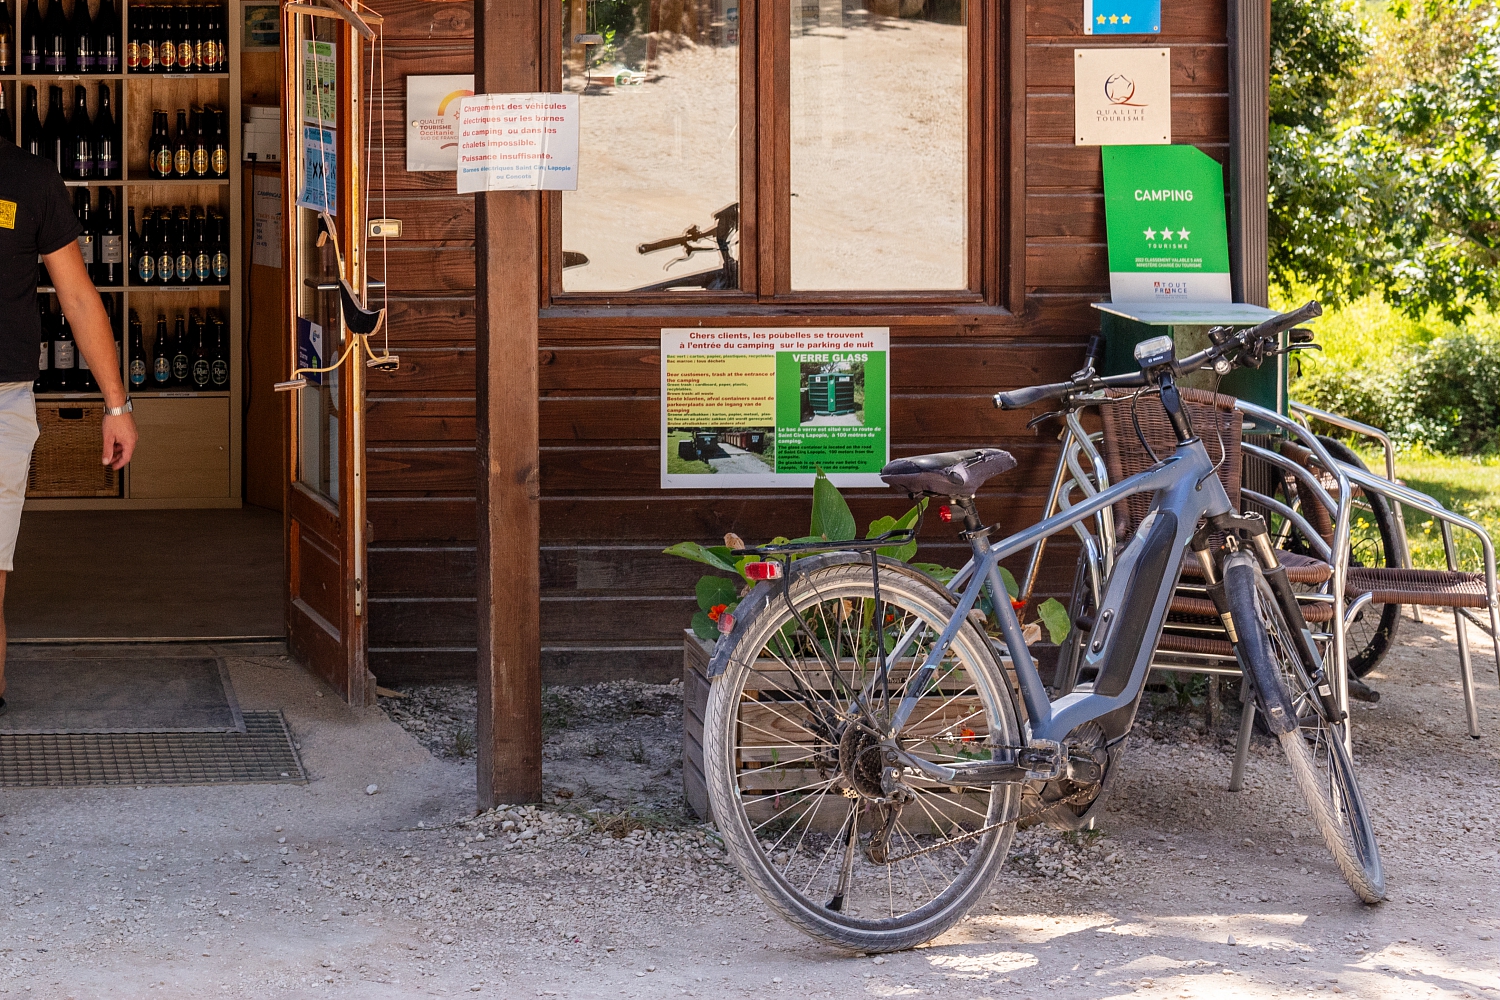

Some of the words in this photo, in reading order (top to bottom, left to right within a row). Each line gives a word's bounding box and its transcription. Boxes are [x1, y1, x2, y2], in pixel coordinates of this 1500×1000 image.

[464, 104, 505, 112] Chargement
[1096, 108, 1144, 116] QUALITÉ
[463, 116, 502, 124] électriques
[472, 128, 502, 136] camping
[462, 141, 486, 149] chalets
[488, 140, 536, 148] impossible.
[1134, 189, 1194, 202] CAMPING
[718, 332, 750, 340] clients,
[768, 332, 811, 340] poubelles
[737, 342, 775, 350] camping
[807, 341, 840, 350] parking
[792, 354, 829, 362] VERRE
[832, 354, 868, 362] GLASS
